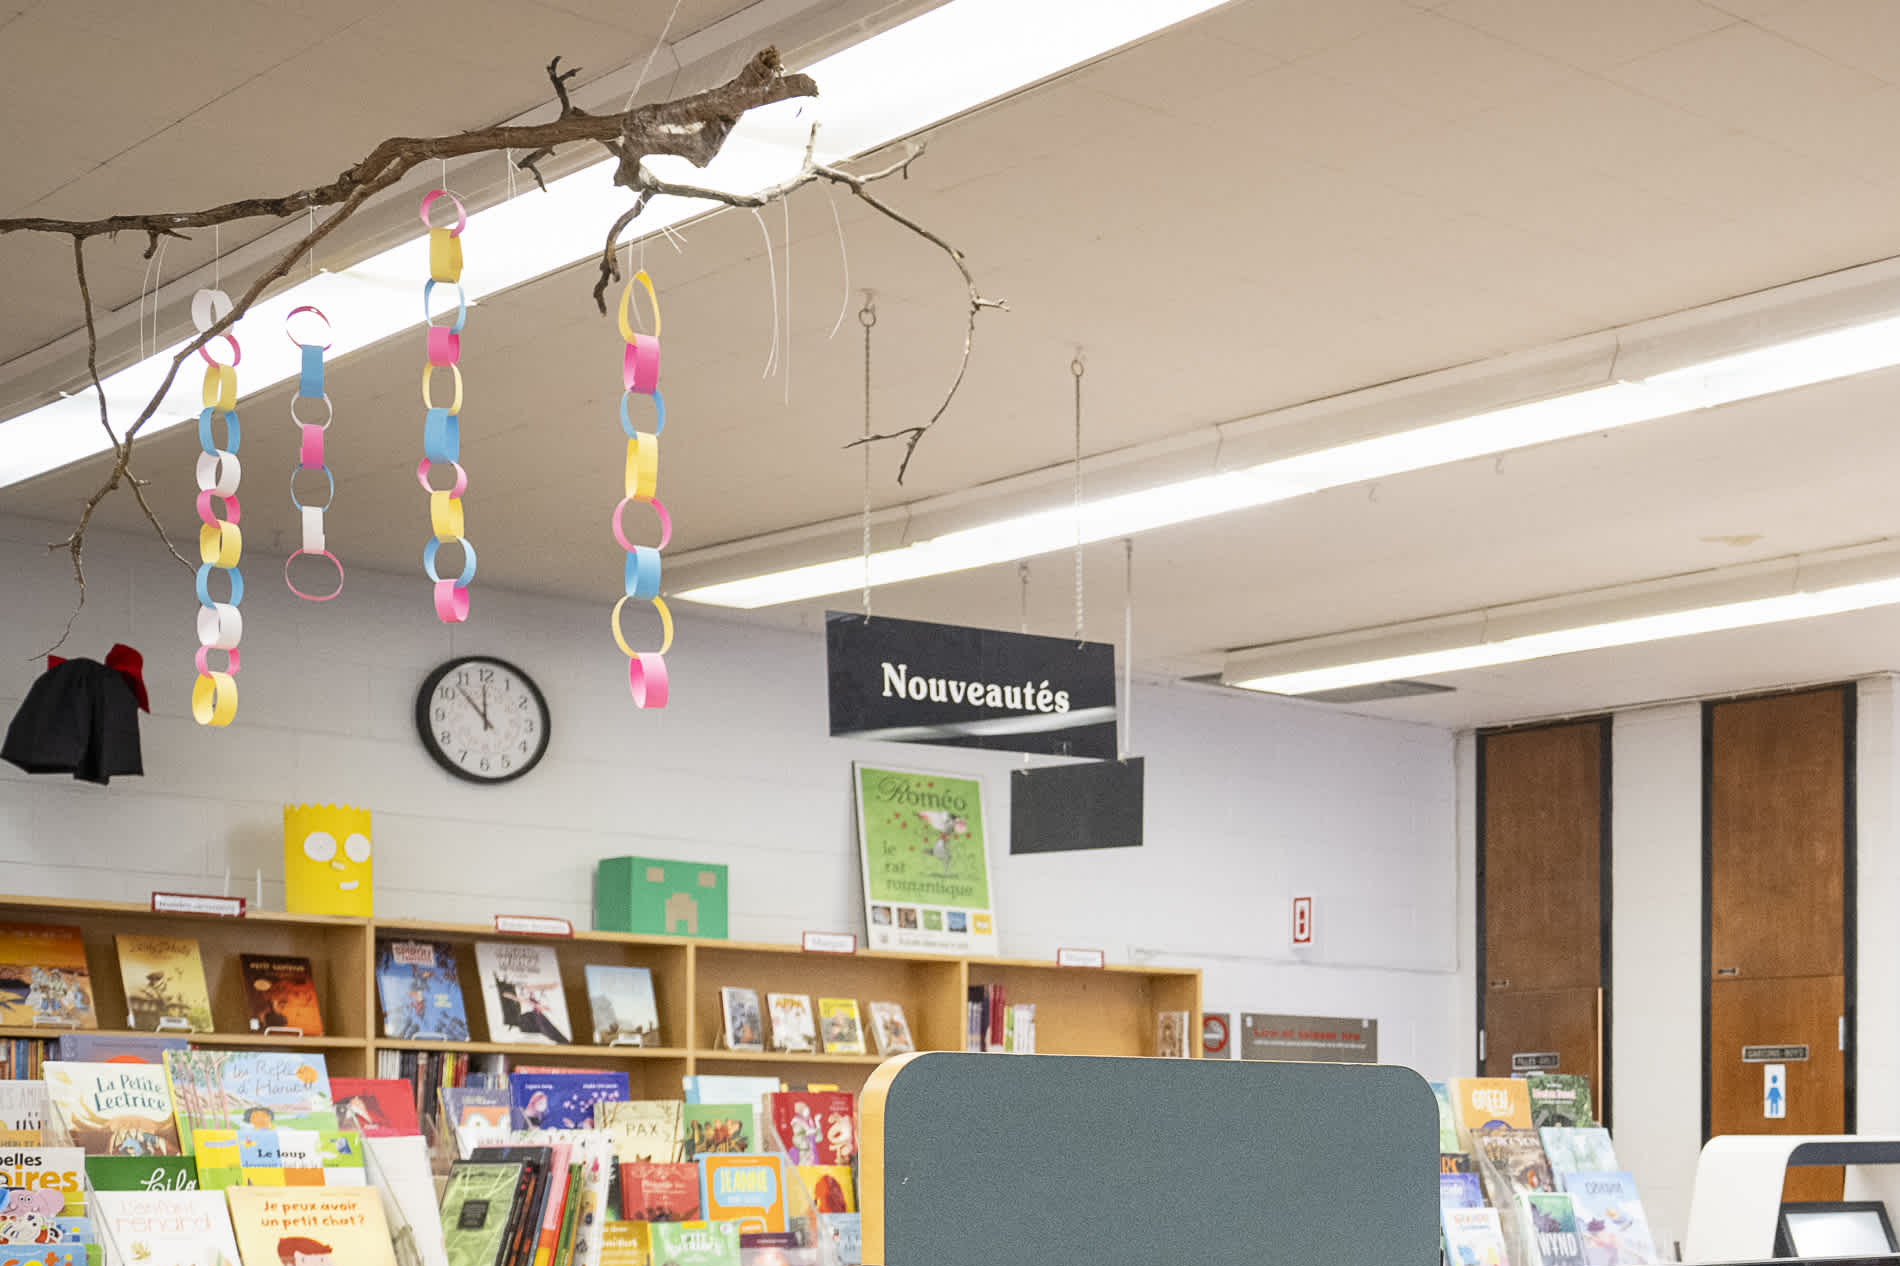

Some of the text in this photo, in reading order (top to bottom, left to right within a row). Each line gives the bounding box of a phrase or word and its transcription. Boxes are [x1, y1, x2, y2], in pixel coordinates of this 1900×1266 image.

[457, 671, 469, 686] 11
[479, 668, 494, 683] 12
[504, 678, 510, 692] 1
[881, 661, 1070, 714] Nouveautés
[438, 687, 456, 701] 10
[518, 695, 529, 710] 2
[434, 707, 445, 722] 9
[524, 718, 534, 733] 3
[440, 731, 451, 745] 8
[519, 740, 527, 753] 4
[457, 750, 468, 763] 7
[480, 757, 490, 771] 6
[502, 754, 511, 769] 5
[877, 775, 968, 812] Roméo
[882, 840, 897, 856] le
[884, 860, 907, 873] rat
[886, 878, 974, 900] romantique
[96, 1074, 163, 1094] La Petite
[94, 1092, 168, 1112] Lectrice
[625, 1122, 657, 1137] PAX
[257, 1148, 307, 1160] Le loup
[720, 1168, 769, 1193] JEANNE
[263, 1199, 357, 1216] Je peux avoir
[261, 1217, 279, 1227] un
[281, 1215, 318, 1231] petit
[1536, 1232, 1579, 1258] WYND
